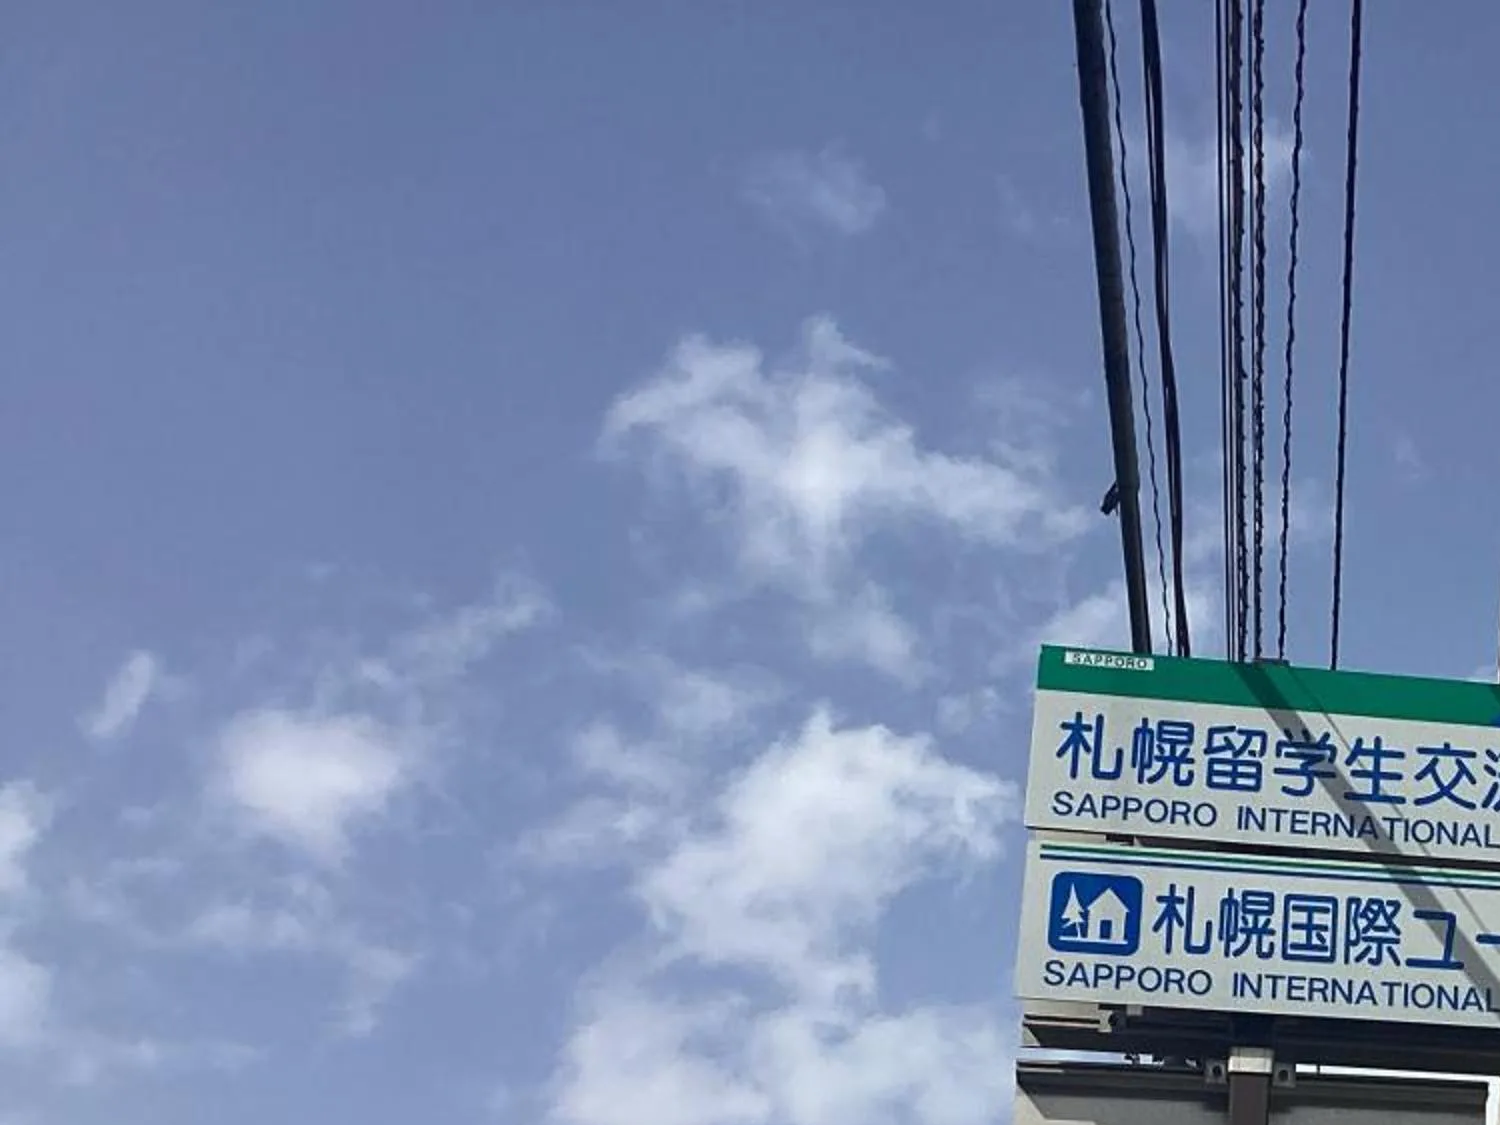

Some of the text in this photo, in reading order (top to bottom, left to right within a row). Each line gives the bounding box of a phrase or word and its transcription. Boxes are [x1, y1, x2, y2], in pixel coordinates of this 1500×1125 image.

[1071, 652, 1148, 669] SAPPORO
[1052, 790, 1218, 828] SAPPORO
[1043, 959, 1213, 996] SAPPORO
